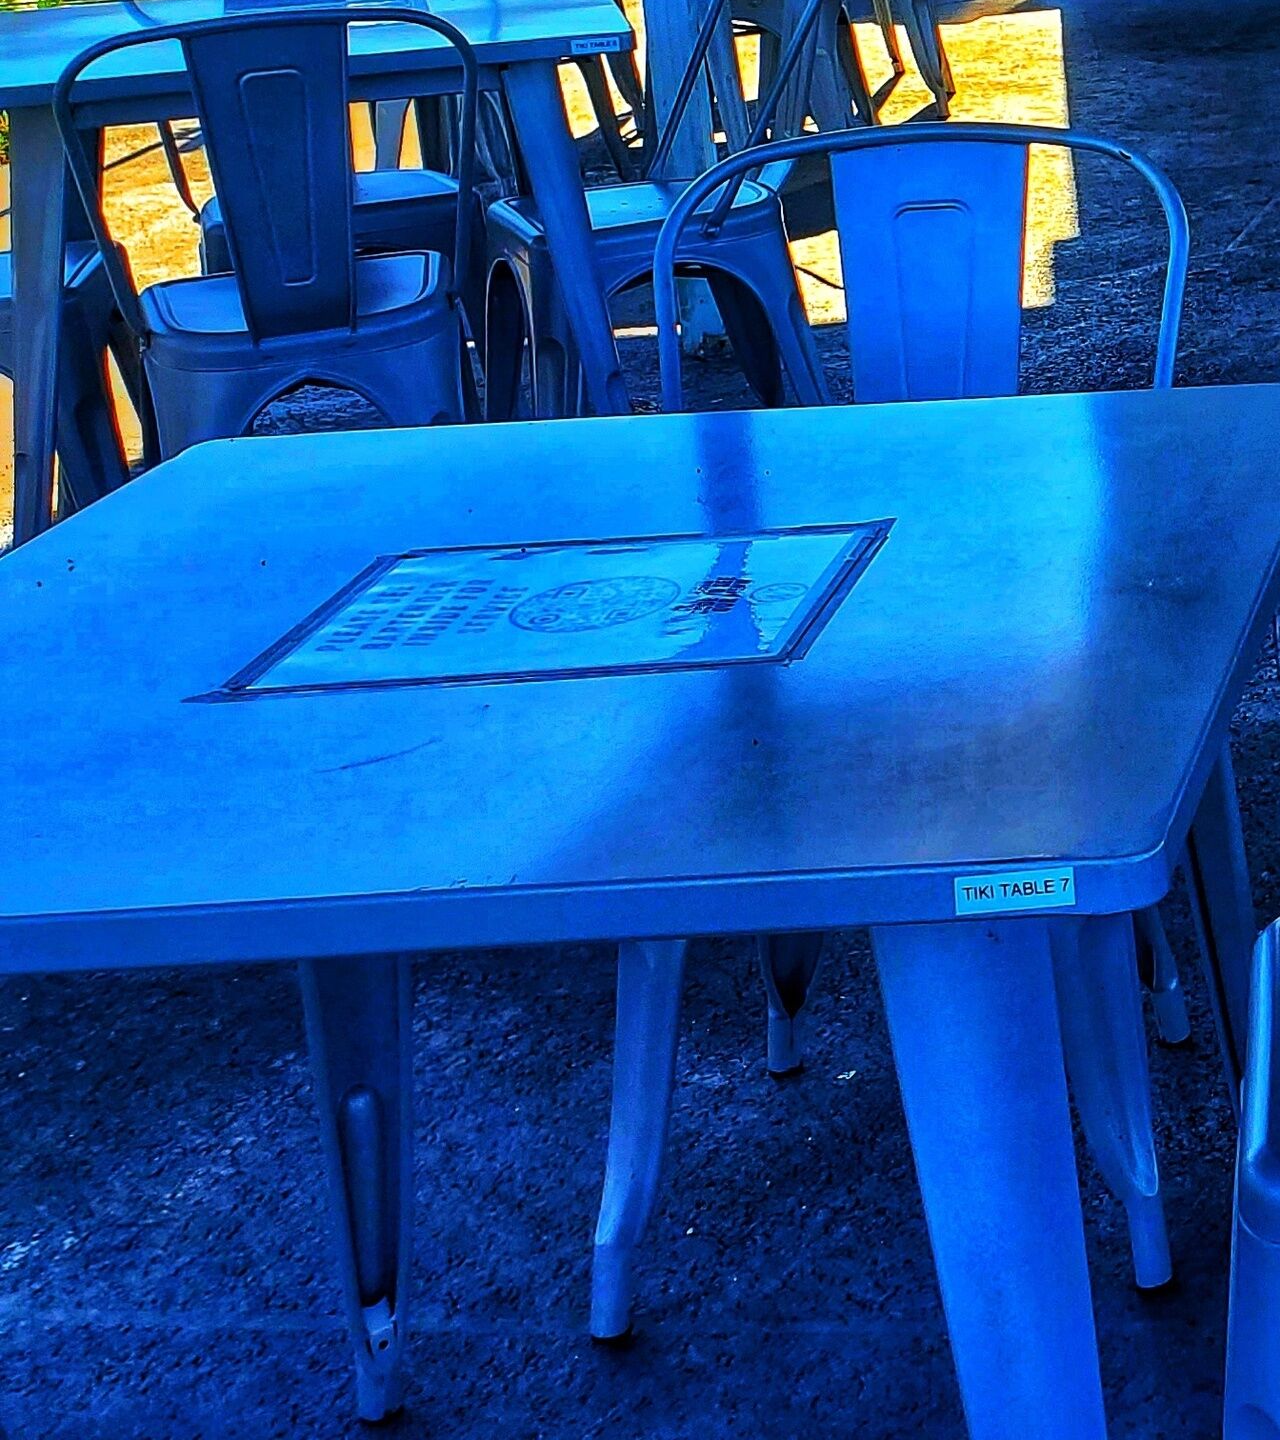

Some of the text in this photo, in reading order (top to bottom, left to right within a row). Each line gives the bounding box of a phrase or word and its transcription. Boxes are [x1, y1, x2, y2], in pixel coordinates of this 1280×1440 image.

[961, 877, 1071, 902] TIKI TABLE 7
